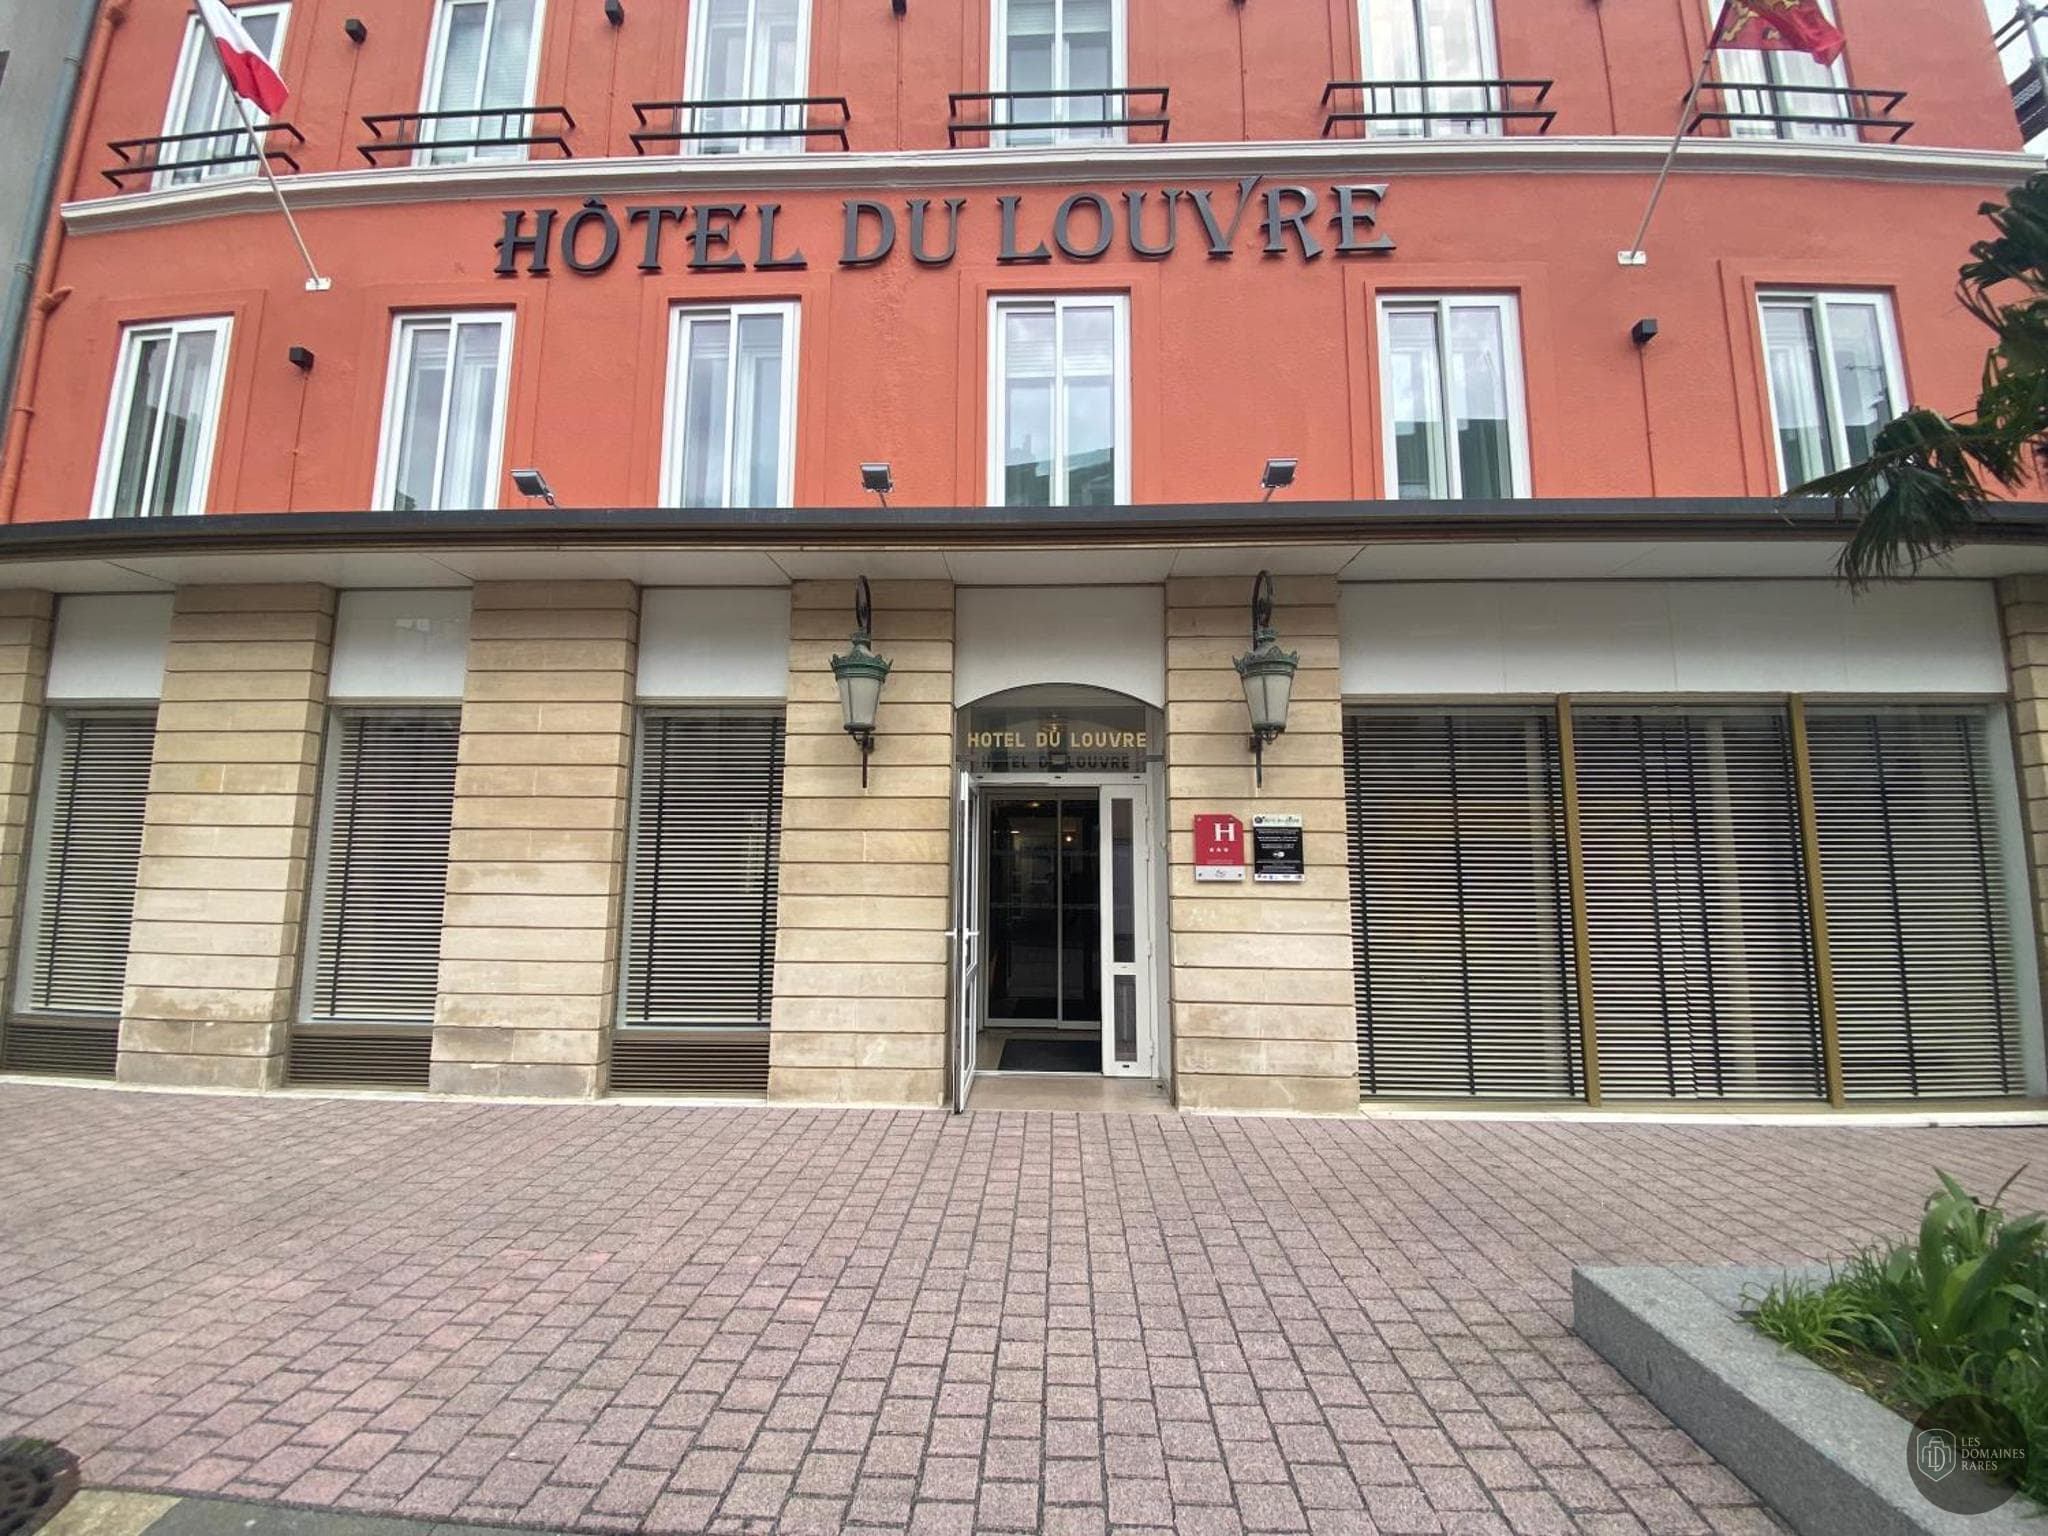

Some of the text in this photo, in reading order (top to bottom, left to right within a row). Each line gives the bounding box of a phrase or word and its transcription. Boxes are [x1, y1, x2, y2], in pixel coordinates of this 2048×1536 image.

[494, 175, 1397, 276] HÔTEL DU LOUVRE
[967, 732, 1147, 748] HOTEL DU LOUVRE
[1214, 823, 1236, 842] H
